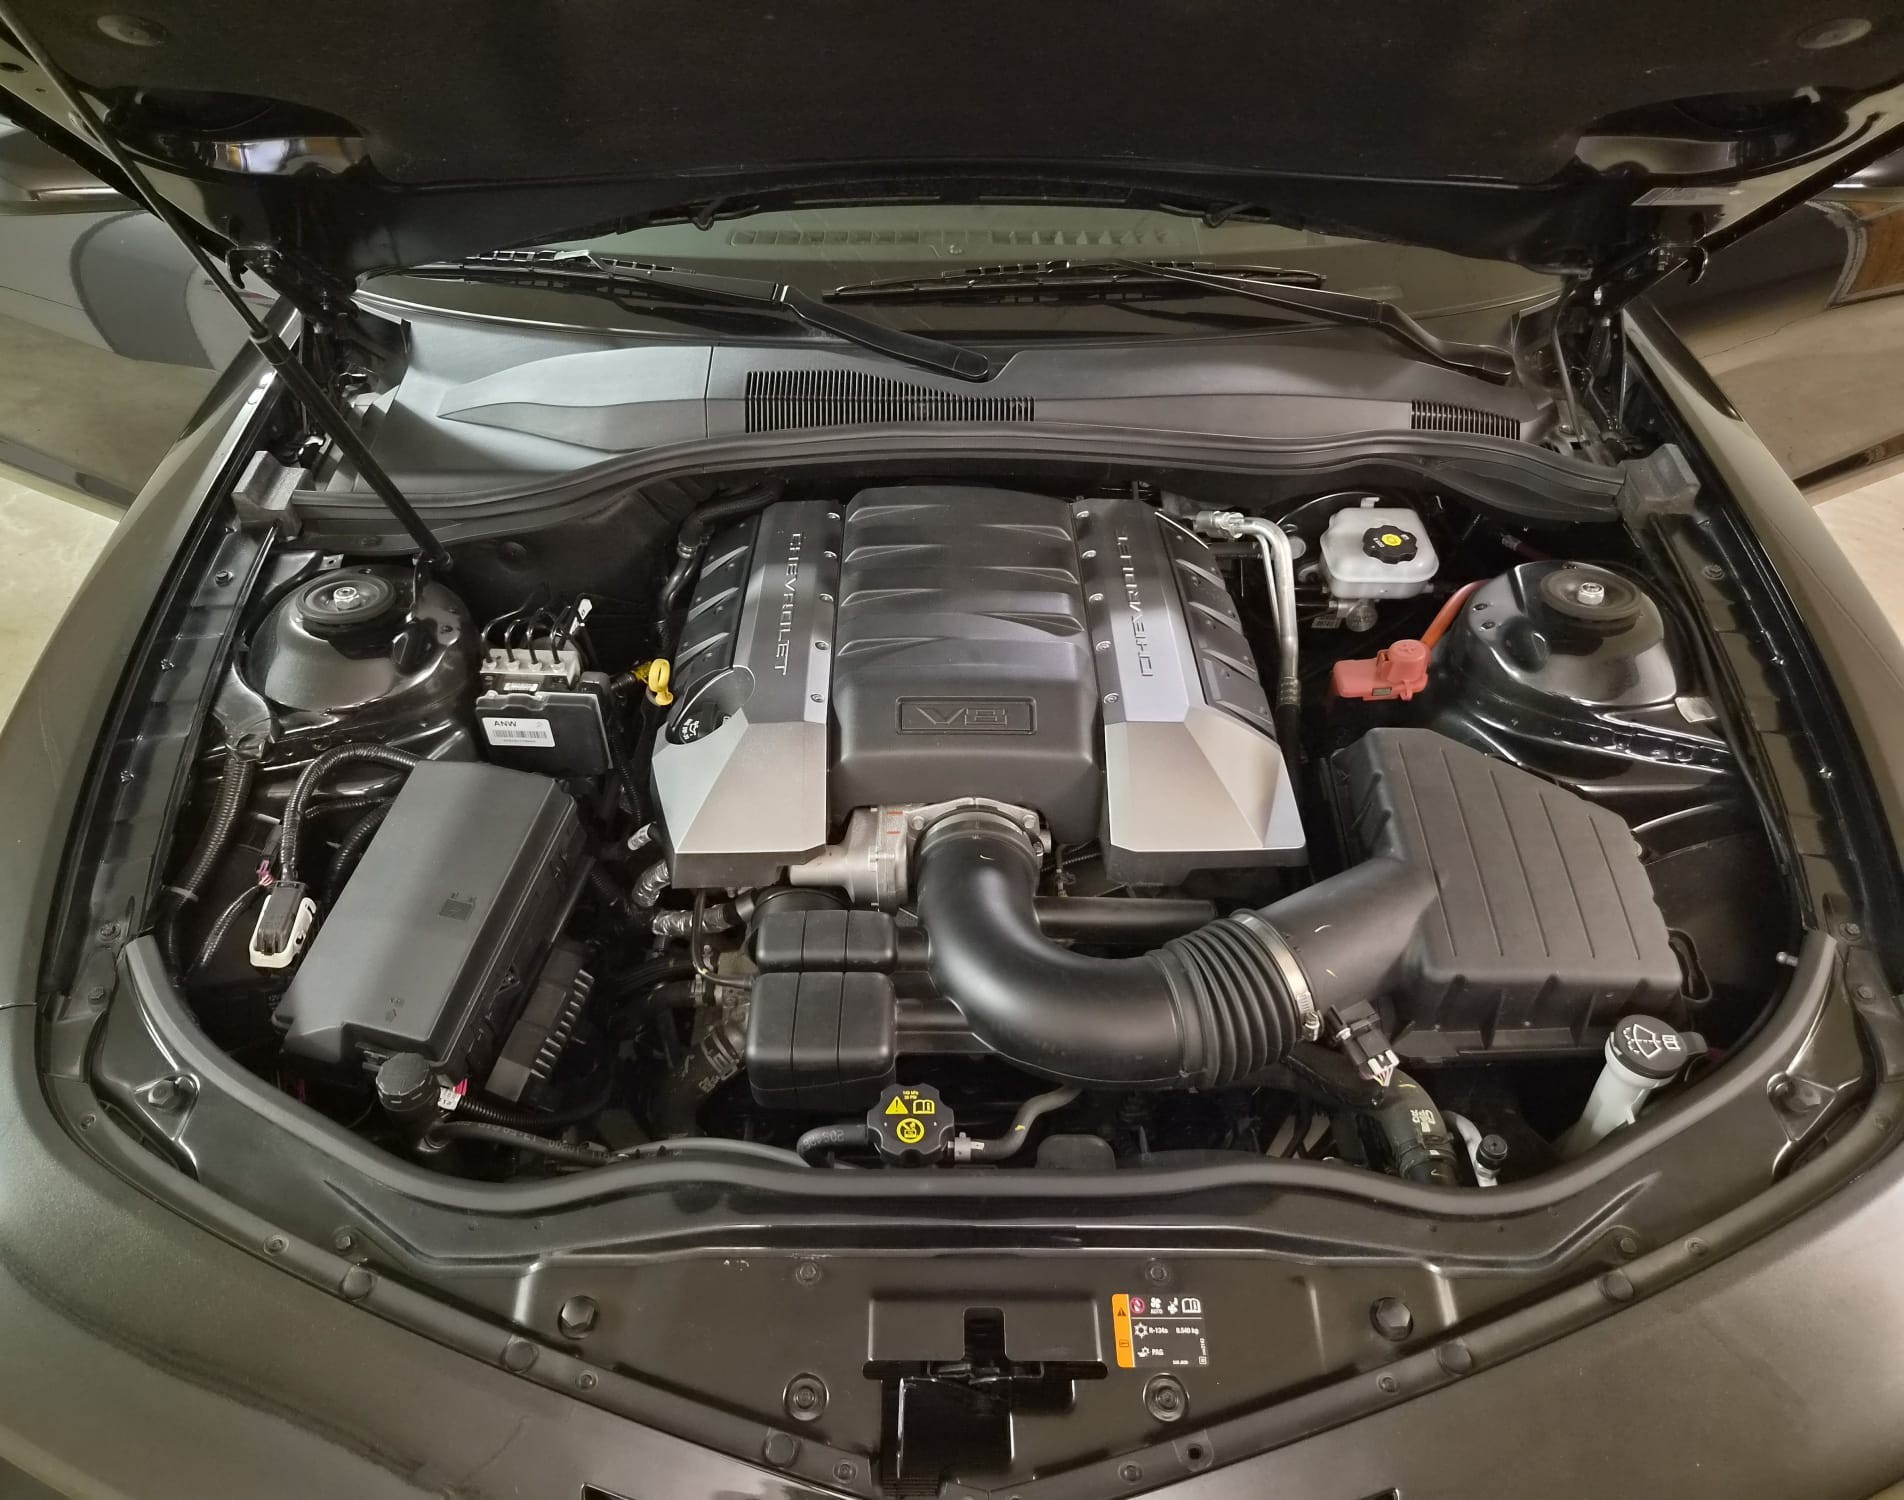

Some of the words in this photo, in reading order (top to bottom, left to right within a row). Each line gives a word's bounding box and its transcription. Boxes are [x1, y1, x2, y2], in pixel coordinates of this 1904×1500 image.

[774, 532, 803, 676] CHEVROLET
[1116, 532, 1154, 677] CHEVROLET
[915, 706, 1007, 727] V8
